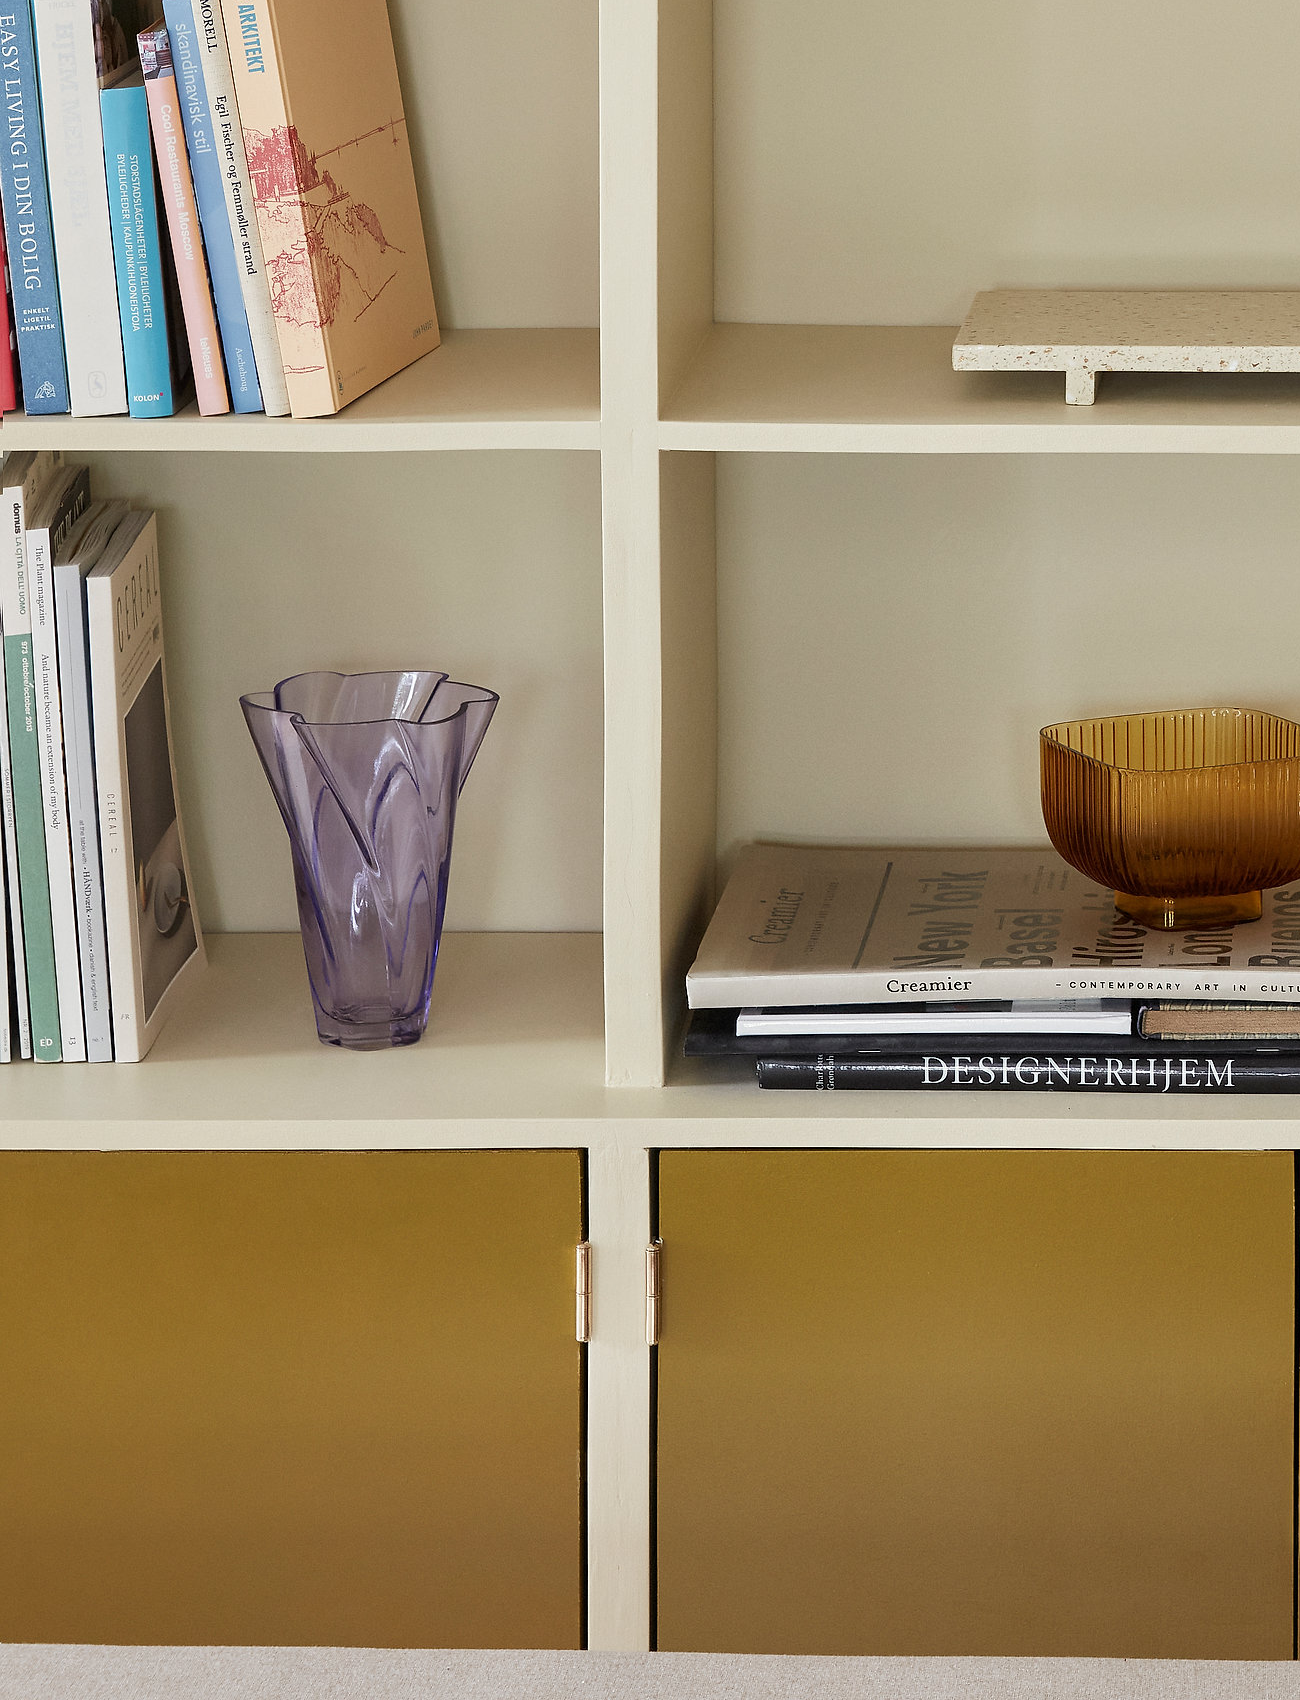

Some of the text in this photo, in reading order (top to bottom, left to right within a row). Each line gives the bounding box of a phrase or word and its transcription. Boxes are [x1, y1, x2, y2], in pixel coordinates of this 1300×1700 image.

[238, 5, 265, 74] ARKITEKT
[175, 23, 211, 154] skandinavisk stil
[0, 14, 41, 290] EASY LIVING I DIN BOLIG
[160, 105, 195, 261] Cool Restaurants Moscow
[215, 96, 257, 275] Egil Fischer og Femmøller strand
[128, 154, 153, 329] STORSTADSLÄGENHETER BYLEILIGHETER
[20, 323, 56, 333] PRAKTISK
[23, 307, 50, 315] ENKELT
[23, 315, 52, 324] LIGETIL
[200, 337, 215, 379] teNeues
[234, 347, 249, 392] Aschehoug
[12, 502, 22, 535] domus
[35, 545, 45, 626] The Plant magazine
[41, 654, 61, 830] And nature became an extension of my body
[106, 793, 118, 836] CEREAL
[82, 871, 93, 913] HÅNDværk
[894, 871, 986, 969] New York
[982, 909, 1064, 969] Basel
[886, 976, 972, 993] Creamier
[1069, 981, 1181, 991] CONTEMPORARY
[1194, 983, 1219, 991] ART
[1233, 984, 1246, 992] IN
[68, 1037, 77, 1046] 13
[922, 1056, 1236, 1091] DESIGNERHJEM
